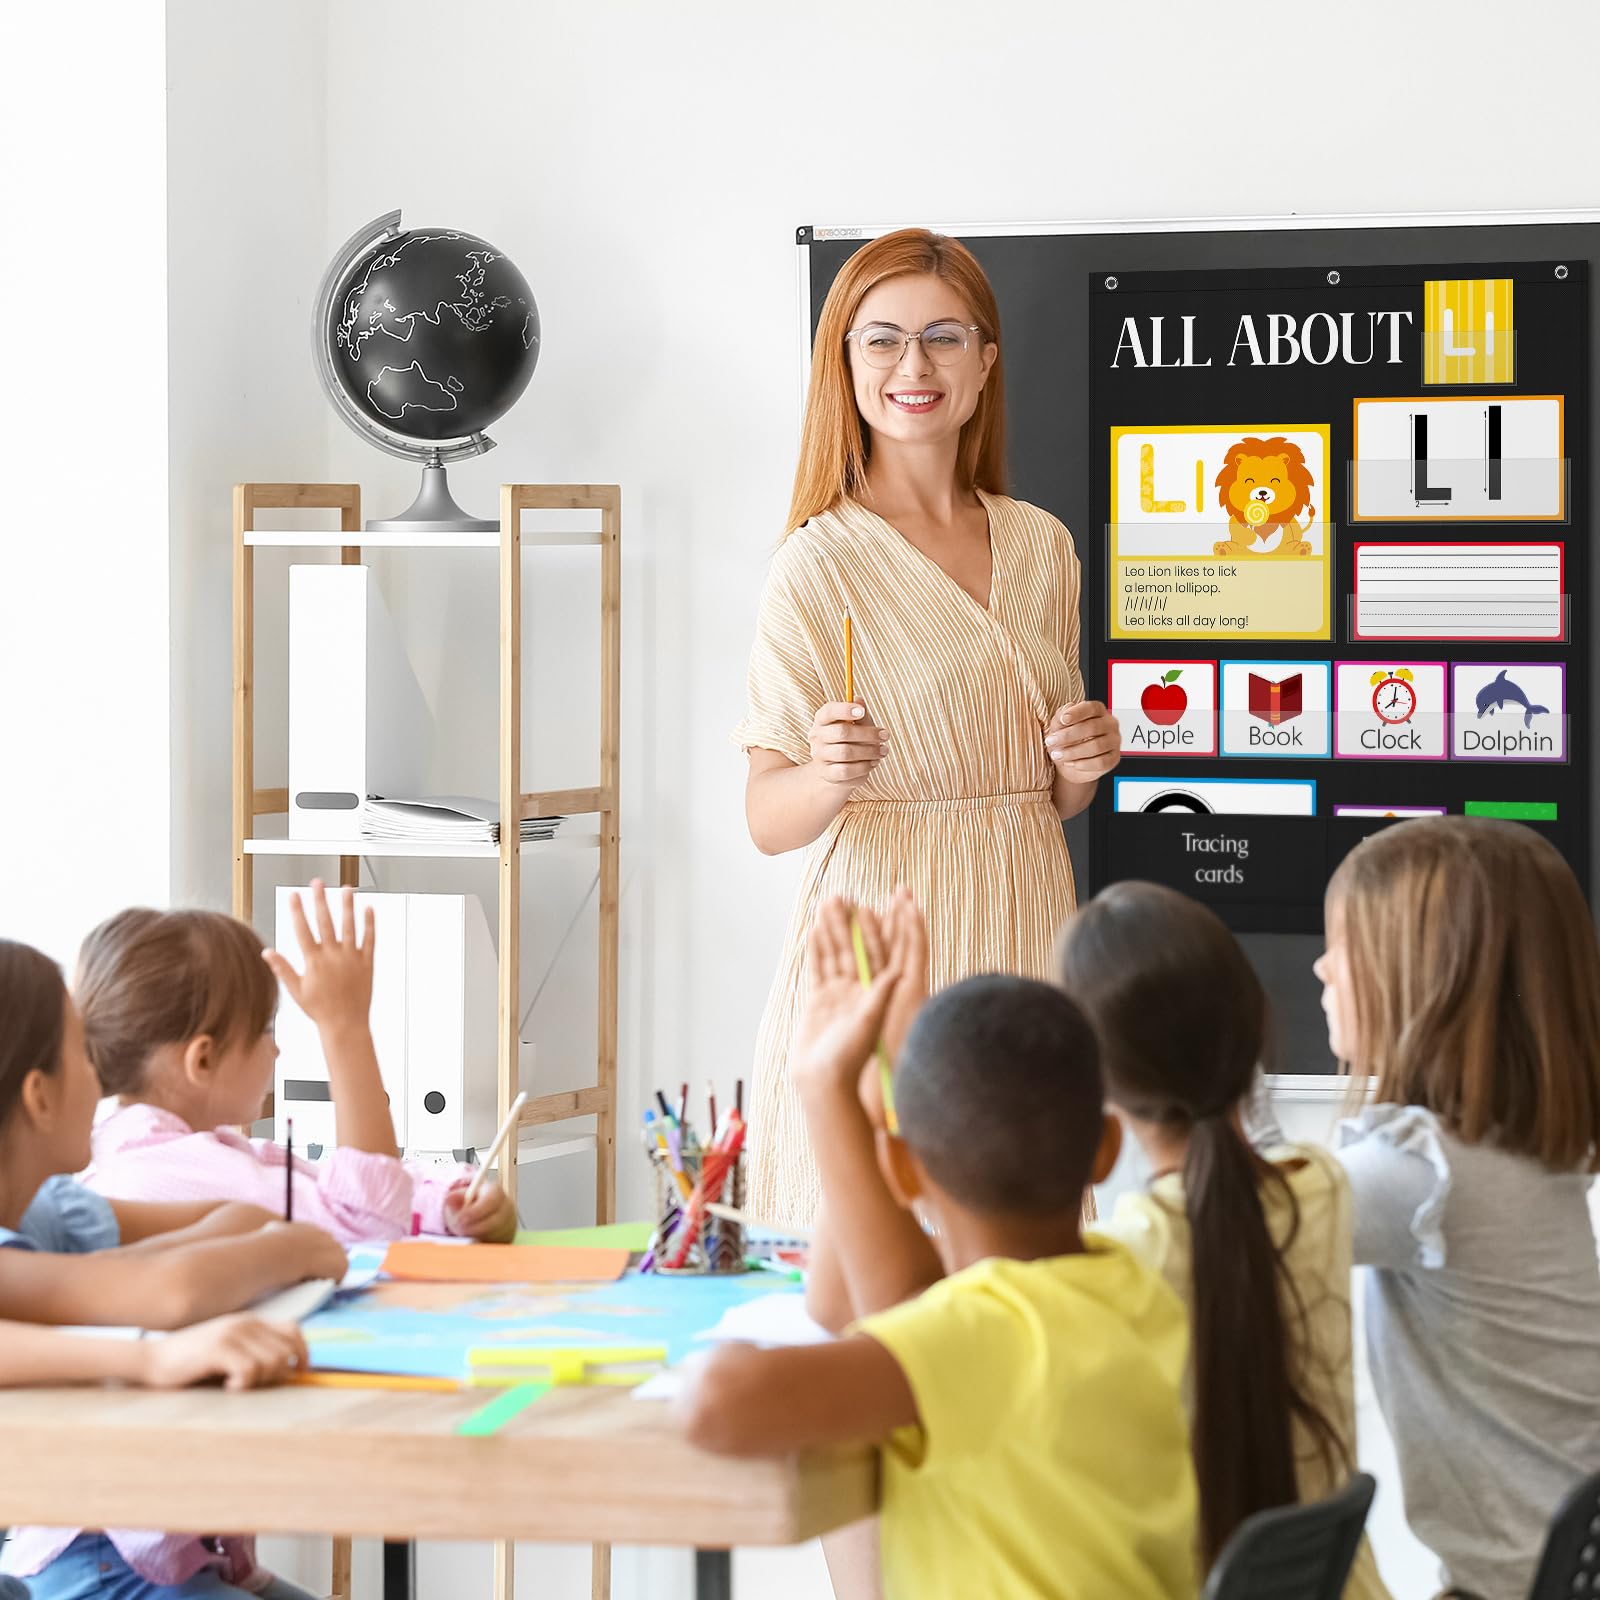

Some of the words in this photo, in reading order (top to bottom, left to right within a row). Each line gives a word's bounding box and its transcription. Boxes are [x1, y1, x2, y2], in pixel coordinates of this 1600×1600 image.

[1110, 316, 1212, 368] ALL
[1226, 311, 1413, 366] ABOUT
[1125, 565, 1145, 577] Leo
[1148, 565, 1171, 577] Lion
[1174, 565, 1200, 577] likes
[1203, 566, 1215, 577] to
[1218, 565, 1237, 577] lick
[1124, 584, 1133, 593] a
[1134, 582, 1172, 593] lemon
[1175, 582, 1221, 596] lollipop.
[1125, 614, 1145, 626] Leo
[1148, 614, 1173, 626] licks
[1176, 614, 1190, 626] all
[1193, 614, 1216, 629] day
[1219, 614, 1249, 629] long!
[1131, 724, 1194, 749] Apple
[1249, 725, 1303, 746] Book
[1360, 728, 1422, 750] Clock
[1463, 730, 1553, 756] Dolphin
[1182, 832, 1249, 859] Tracing
[1195, 864, 1244, 883] cards
